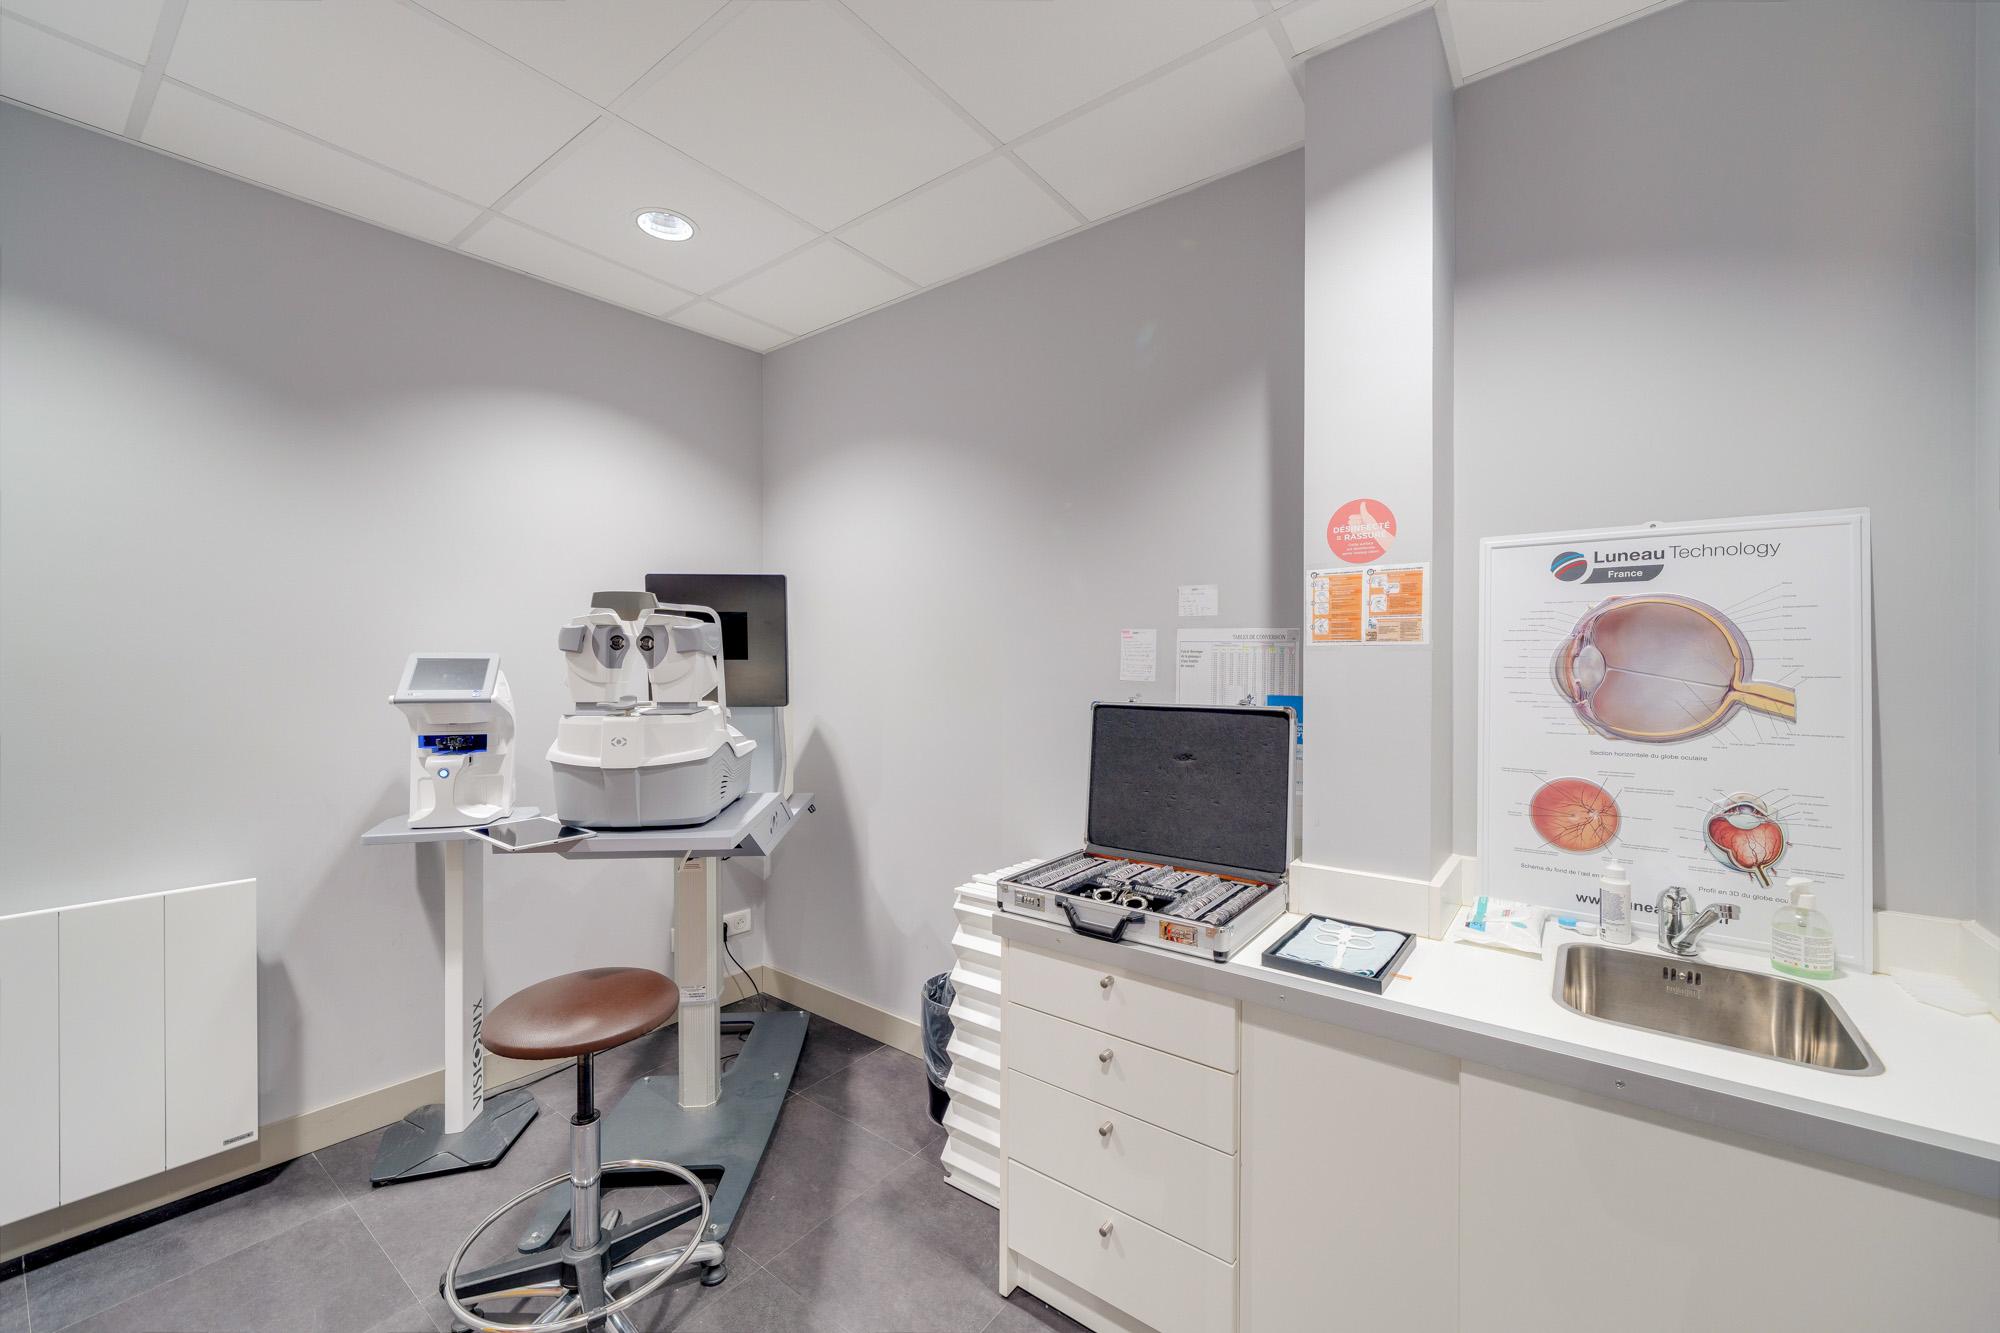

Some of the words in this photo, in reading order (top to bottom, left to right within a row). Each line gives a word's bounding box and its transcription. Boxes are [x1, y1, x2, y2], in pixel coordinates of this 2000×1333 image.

[1594, 549, 1665, 564] Luneau
[1669, 541, 1782, 559] Technology
[1607, 569, 1643, 579] France
[1589, 749, 1613, 757] Section
[1614, 750, 1649, 759] horizontale
[1660, 752, 1679, 761] globe
[1680, 754, 1708, 762] oculaire
[1568, 868, 1577, 876] de
[1698, 886, 1716, 895] Profil
[1741, 891, 1751, 899] du
[1752, 892, 1774, 902] globe
[472, 998, 483, 1111] VISIONIX
